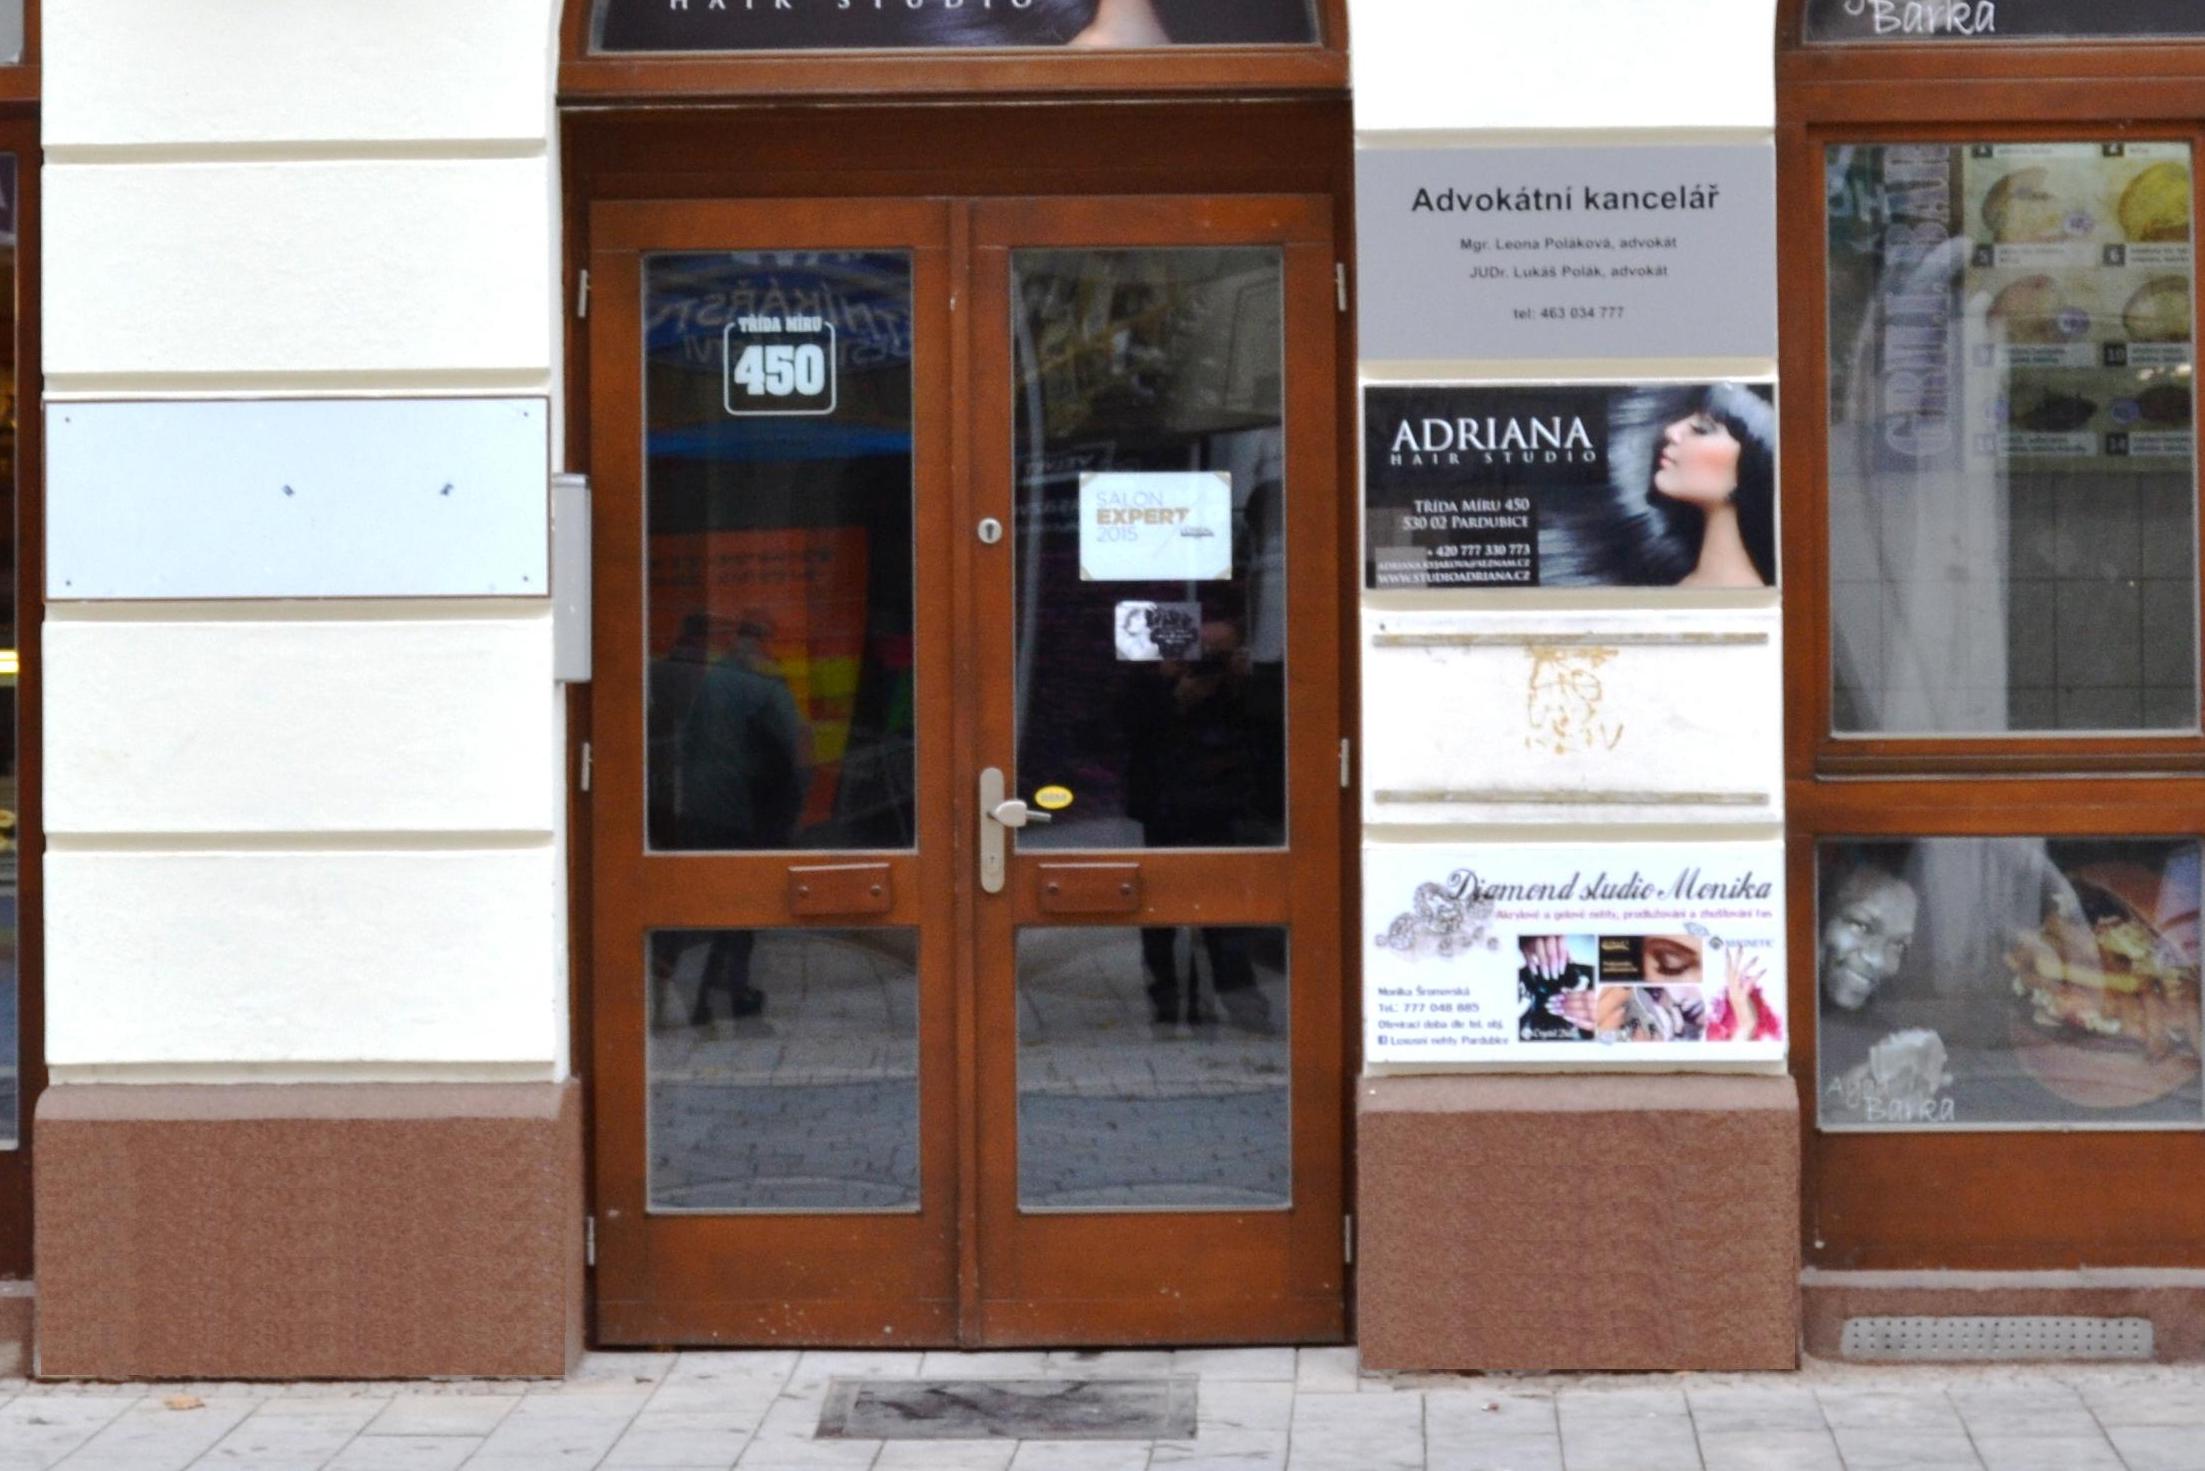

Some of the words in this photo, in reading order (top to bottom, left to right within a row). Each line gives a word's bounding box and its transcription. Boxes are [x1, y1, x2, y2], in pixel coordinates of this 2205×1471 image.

[1872, 0, 1997, 35] Barka
[1411, 186, 1573, 213] Advokátní
[1584, 184, 1720, 211] kancelář
[1460, 237, 1490, 252] Mgr.
[1496, 237, 1540, 250] Leona
[1545, 237, 1615, 251] Poláková,
[1620, 236, 1678, 250] advokát
[1469, 266, 1509, 279] JUDr.
[1514, 264, 1557, 278] Lukáš
[1611, 264, 1668, 278] advokát
[1540, 306, 1566, 320] 463
[1570, 306, 1595, 320] 034
[1600, 306, 1624, 320] 777
[738, 314, 782, 333] TŘÍDA
[786, 313, 823, 333] MÍRU
[734, 344, 826, 396] 450
[1391, 416, 1594, 452] ADRIANA
[1391, 452, 1461, 466] HAIR
[1485, 450, 1597, 465] STUDIO
[1096, 491, 1164, 507] SALON
[1414, 499, 1459, 513] TŘÍDA
[1462, 498, 1500, 512] MÍRU
[1505, 498, 1530, 511] 450
[1096, 508, 1190, 525] EXPERT
[1430, 516, 1447, 530] 02
[1452, 515, 1529, 529] PARDUBICE
[1096, 527, 1139, 542] 2015
[1436, 545, 1458, 557] 420
[1461, 544, 1482, 556] 777
[1378, 570, 1530, 584] WWW.STUDIOADRIANA.CZ
[1447, 868, 1580, 905] Diamond
[1579, 871, 1655, 901] studio
[1657, 867, 1773, 901] Monika
[1404, 1003, 1425, 1013] 777
